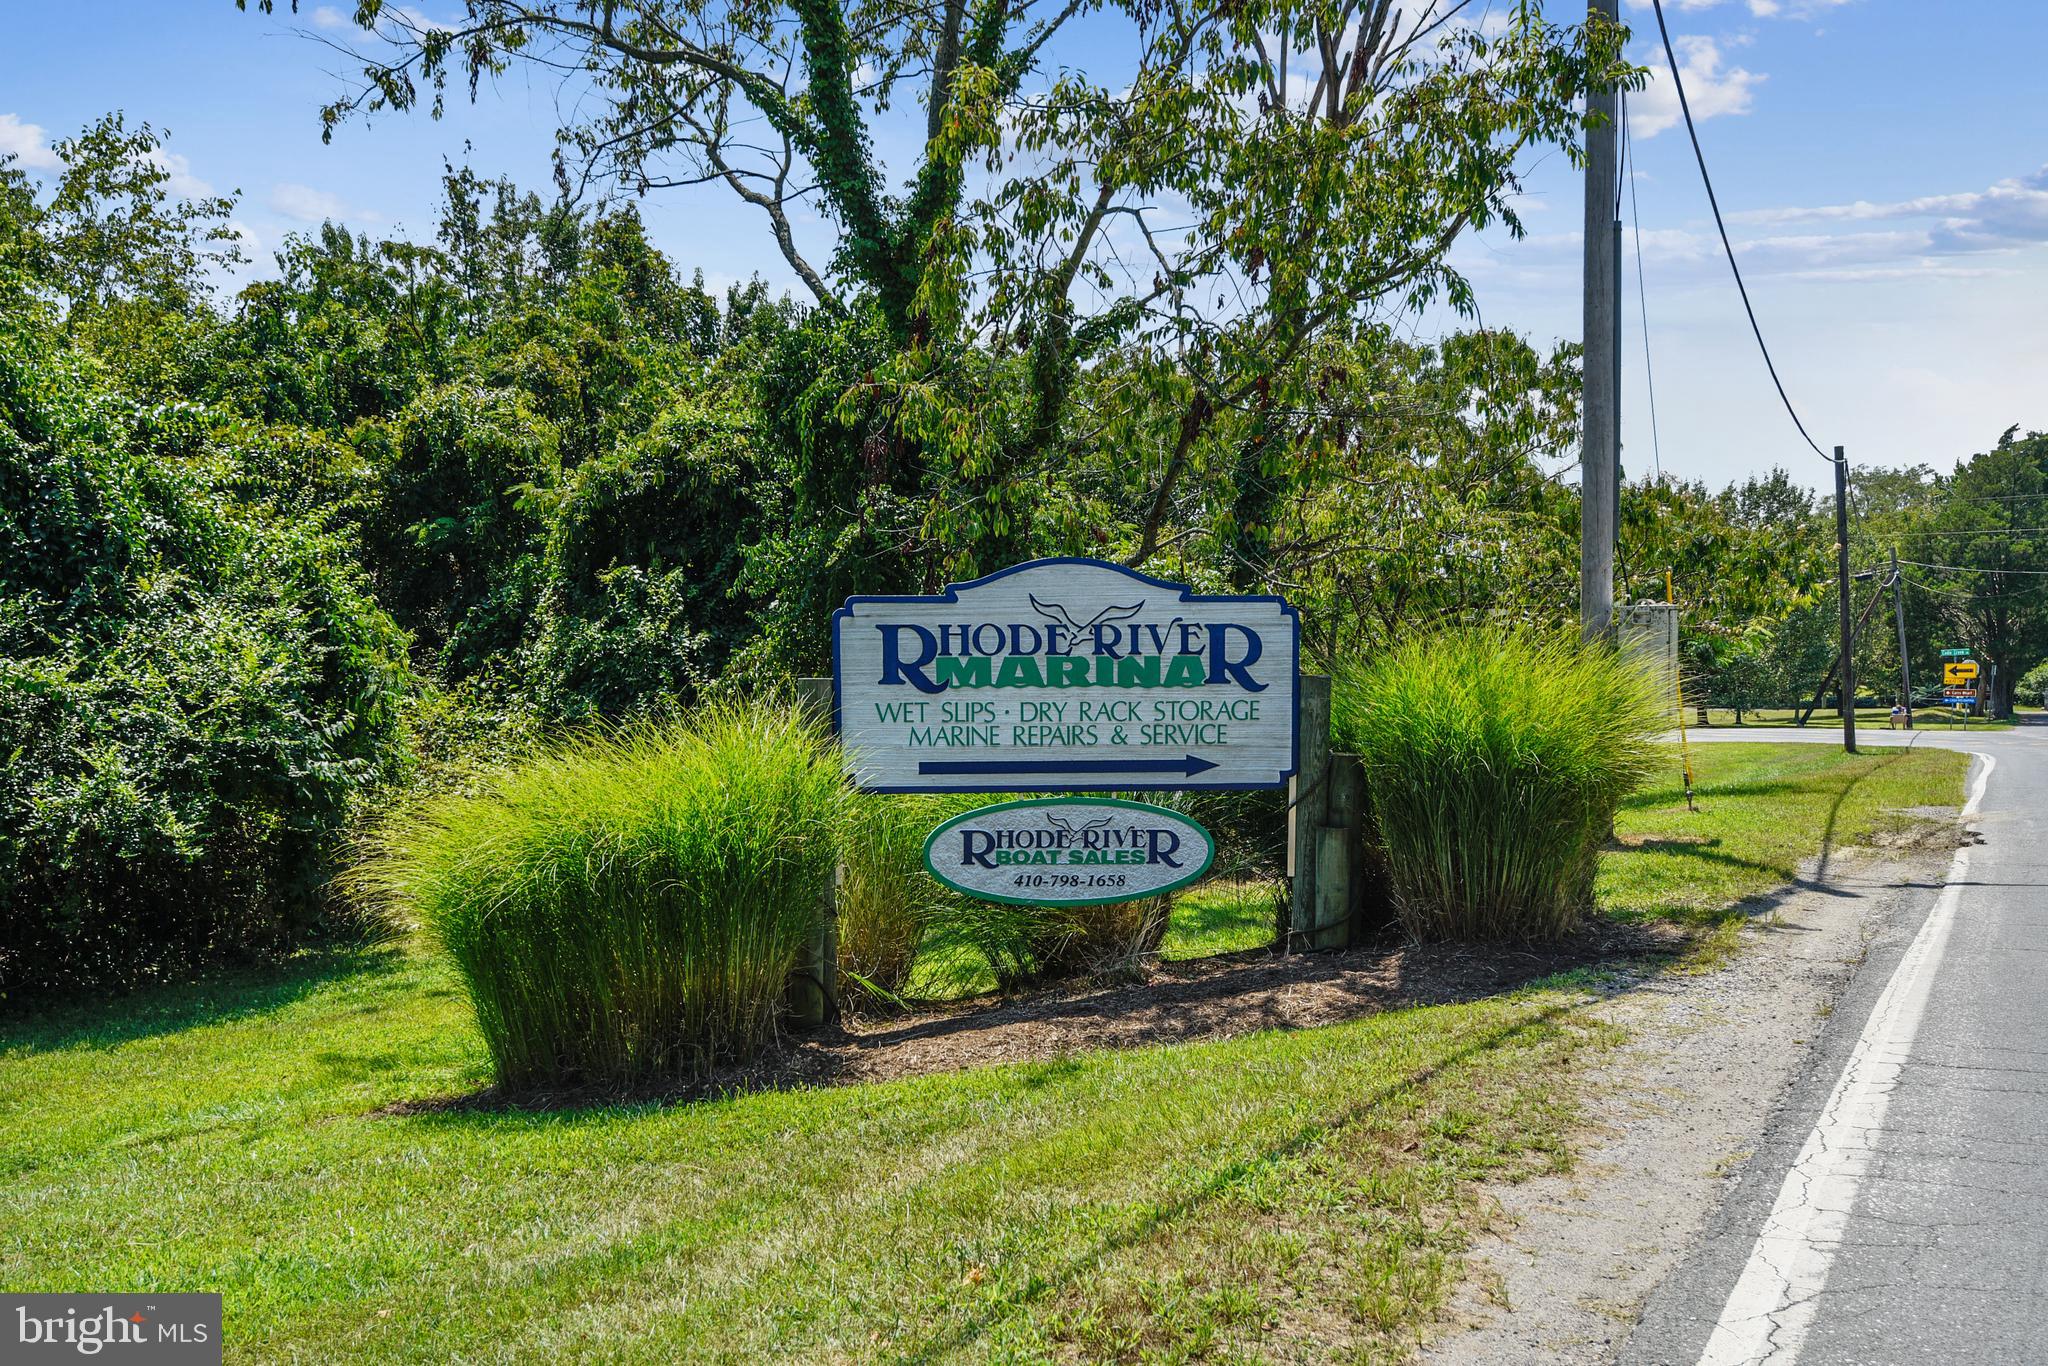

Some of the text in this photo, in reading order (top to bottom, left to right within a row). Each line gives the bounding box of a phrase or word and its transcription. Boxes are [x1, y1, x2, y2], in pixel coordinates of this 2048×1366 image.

[875, 616, 1270, 694] RHODE RIVER
[936, 655, 1206, 689] MARINA
[875, 700, 1261, 723] WET SLIPS DRY RACK STORAGE
[908, 725, 1228, 747] MARINE REPAIRS & SERVICE
[959, 826, 1184, 869] RHODE RIVER
[996, 849, 1146, 865] BOAT SALES
[1013, 874, 1126, 888] 410-798-1658
